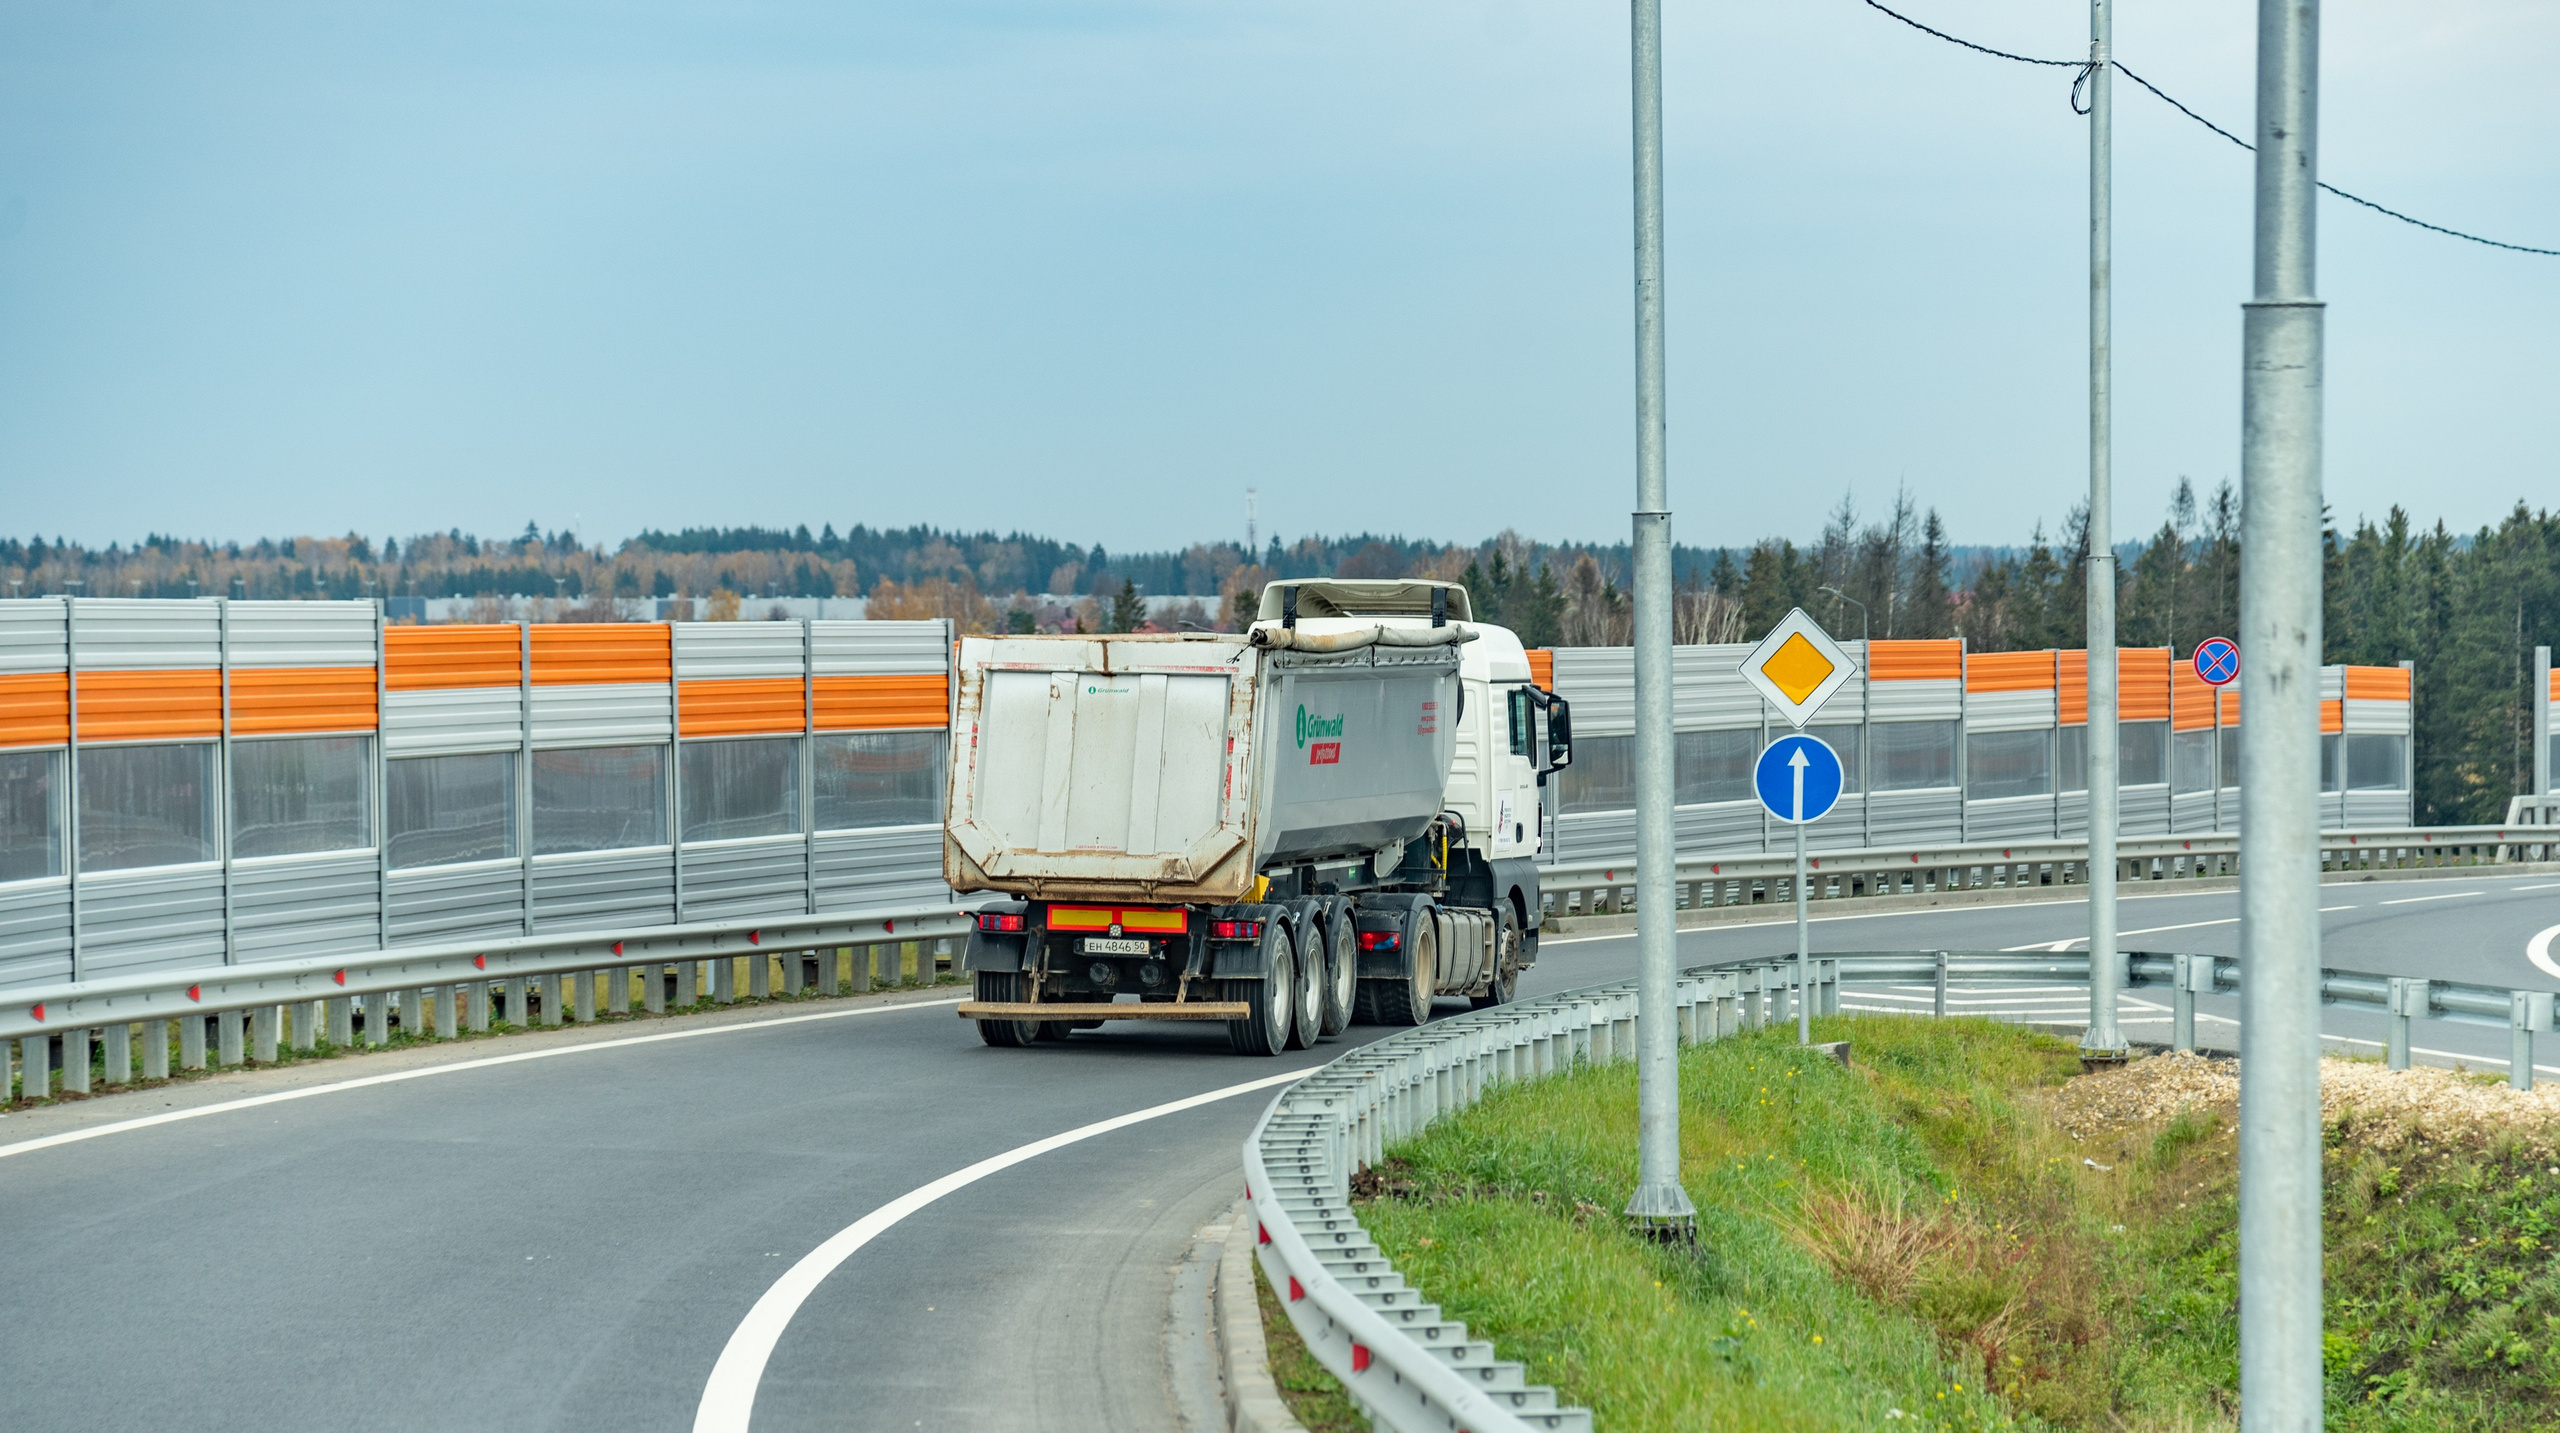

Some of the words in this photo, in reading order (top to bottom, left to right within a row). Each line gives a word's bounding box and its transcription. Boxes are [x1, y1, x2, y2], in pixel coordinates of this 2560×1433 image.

[1307, 713, 1344, 738] Grünwald
[1089, 942, 1102, 951] EH
[1105, 941, 1132, 952] 4846
[1134, 941, 1145, 950] 50
